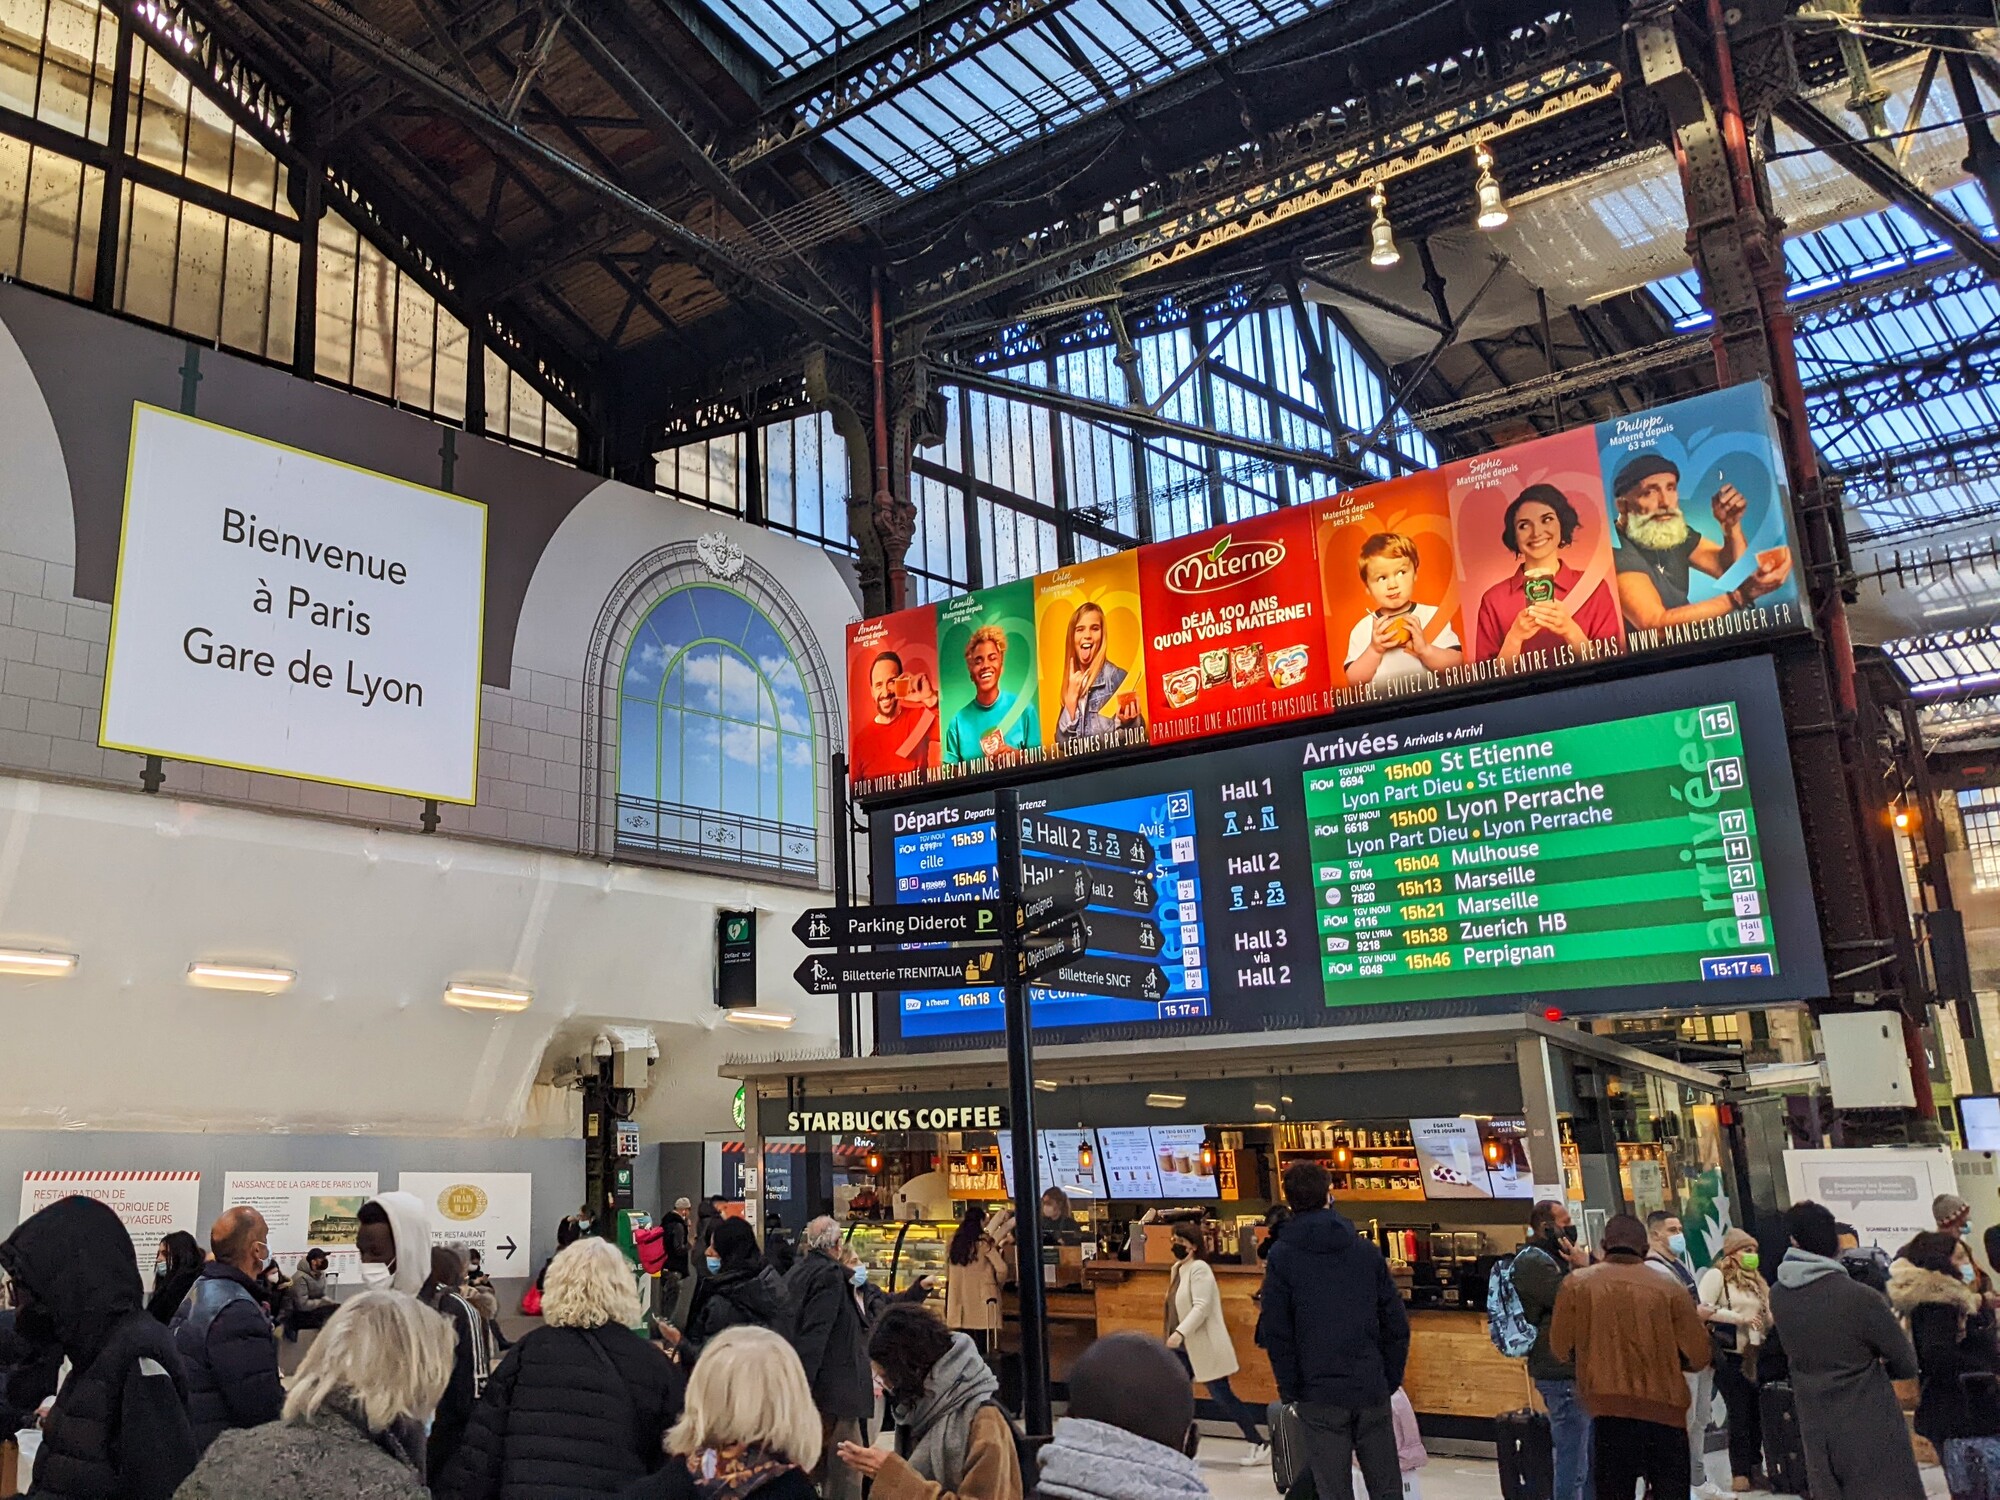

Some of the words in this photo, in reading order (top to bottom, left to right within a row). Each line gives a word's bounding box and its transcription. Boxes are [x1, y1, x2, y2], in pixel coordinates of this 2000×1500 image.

[1609, 428, 1644, 446] Materné
[1645, 422, 1674, 438] depuis
[1616, 415, 1664, 434] Philippe
[1468, 457, 1502, 474] Sophie
[1456, 470, 1497, 487] Maternée
[1498, 464, 1519, 478] depuis
[1322, 508, 1350, 520] Materné
[1352, 501, 1374, 514] depuis
[1339, 494, 1354, 508] Léo
[222, 507, 407, 585] Bienvenue
[1174, 547, 1284, 588] Materne
[252, 578, 272, 614] à
[288, 585, 371, 636] Paris
[1182, 608, 1216, 630] DÉJÀ
[1219, 603, 1244, 622] 100
[1250, 596, 1278, 614] ANS
[858, 620, 884, 636] Arnaud
[1154, 630, 1192, 651] QU'ON
[1198, 619, 1232, 640] VOUS
[1236, 604, 1304, 633] MATERNE
[1306, 602, 1312, 617] !
[183, 627, 275, 676] Gare
[288, 648, 333, 688] de
[346, 660, 424, 707] Lyon
[1152, 716, 1201, 740] PRATIQUEZ
[1204, 712, 1222, 730] UNE
[1226, 702, 1268, 726] ACTIVITÉ
[1272, 692, 1318, 720] PHYSIQUE
[1388, 674, 1422, 698] ÉVITEZ
[1426, 669, 1441, 690] DE
[1444, 657, 1507, 686] GRIGNOTER
[1512, 648, 1549, 674] ENTRE
[1554, 644, 1575, 667] LES
[1580, 638, 1624, 662] REPAS.
[1628, 602, 1792, 652] WWW.MANGERBOUGER.FR
[1302, 733, 1399, 765] Arrivées
[1403, 731, 1444, 748] Arrivals
[1454, 724, 1484, 740] Arrivi
[854, 780, 872, 797] POUR
[874, 775, 896, 792] VOTRE
[926, 762, 955, 784] MANGEZ
[958, 762, 968, 778] AU
[970, 754, 994, 776] MOINS
[998, 750, 1016, 770] CINQ
[1020, 744, 1047, 766] FRUITS
[1051, 742, 1060, 762] ET
[1064, 735, 1100, 758] LÉGUMES
[1104, 730, 1120, 750] PAR
[1124, 726, 1150, 746] JOUR.
[1338, 767, 1353, 776] TGV
[1354, 764, 1376, 774] INOUI
[1384, 760, 1432, 782] 15h00
[1440, 751, 1464, 772] St
[1468, 740, 1554, 764] Etienne
[1340, 774, 1364, 788] 6694
[1342, 788, 1379, 812] Lyon
[1384, 782, 1418, 802] Part
[1423, 778, 1463, 796] Dieu
[1476, 770, 1496, 788] St
[1502, 761, 1572, 785] Etienne
[1222, 780, 1258, 802] Hall
[1389, 806, 1438, 828] 15h00
[1446, 799, 1498, 824] Lyon
[1504, 781, 1604, 812] Perrache
[894, 806, 960, 832] Départs
[1343, 814, 1358, 824] TGV
[1358, 810, 1381, 820] INOUI
[1037, 822, 1069, 848] Hall
[1072, 829, 1082, 850] 2
[1344, 822, 1369, 834] 6618
[1347, 837, 1384, 857] Lyon
[1390, 831, 1424, 850] Part
[1428, 826, 1468, 844] Dieu
[1483, 819, 1526, 840] Lyon
[1530, 806, 1613, 831] Perrache
[950, 830, 984, 848] 15h39
[920, 854, 944, 870] eille
[1228, 855, 1266, 876] Hall
[1268, 852, 1280, 870] 2
[1348, 860, 1364, 869] TGV
[1394, 854, 1440, 874] 15h04
[1452, 843, 1540, 866] Mulhouse
[952, 870, 986, 886] 15h46
[1350, 868, 1373, 880] 6704
[1397, 878, 1442, 897] 15h13
[1454, 866, 1536, 891] Marseille
[1350, 882, 1376, 892] OUIGO
[1026, 896, 1054, 918] Consignes
[1352, 892, 1376, 904] 7820
[1400, 902, 1445, 921] 15h21
[1457, 891, 1539, 916] Marseille
[1353, 907, 1368, 916] TGV
[1368, 904, 1392, 915] INOUI
[848, 918, 904, 934] Parking
[908, 915, 966, 931] Diderot
[978, 910, 994, 930] P
[1354, 916, 1378, 928] 6116
[1402, 927, 1448, 946] 15h38
[1460, 918, 1528, 940] Zuerich
[1538, 912, 1568, 933] HB
[1234, 930, 1272, 950] Hall
[1276, 928, 1288, 946] 3
[1356, 932, 1372, 941] TGV
[1371, 929, 1393, 940] LYRIA
[1027, 947, 1044, 968] Objets
[1044, 938, 1064, 962] trouvés
[1356, 940, 1380, 952] 9218
[1253, 952, 1270, 964] via
[1358, 955, 1374, 964] TGV
[1374, 952, 1396, 963] INOUI
[1405, 952, 1452, 970] 15h46
[1464, 944, 1554, 967] Perpignan
[842, 970, 896, 982] Billetterie
[897, 966, 963, 978] TRENITALIA
[1058, 968, 1104, 985] Billetterie
[1106, 974, 1132, 988] SNCF
[1238, 967, 1276, 988] Hall
[1279, 966, 1292, 984] 2
[1360, 964, 1383, 976] 6048
[1710, 962, 1748, 976] 15:17
[821, 982, 836, 990] min
[958, 992, 990, 1006] 16h18
[788, 1108, 912, 1132] STARBUCKS
[916, 1106, 1001, 1130] COFFEE
[112, 1190, 126, 1198] DE
[232, 1180, 276, 1189] NAISSANCE
[277, 1180, 288, 1188] DE
[289, 1180, 298, 1188] LA
[300, 1180, 320, 1188] GARE
[111, 1202, 154, 1212] TORIQUE
[156, 1202, 170, 1212] DE
[120, 1214, 172, 1224] OYAGEURS
[444, 1230, 486, 1238] RESTAURANT
